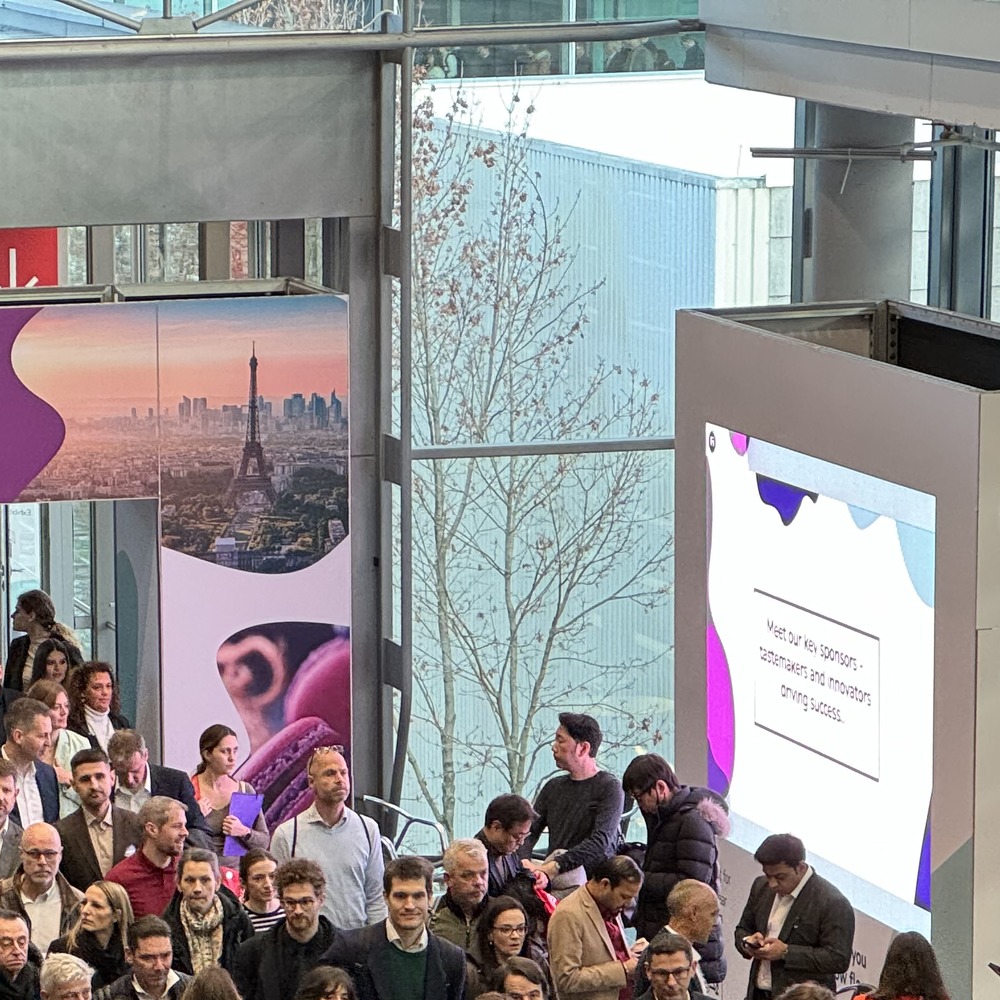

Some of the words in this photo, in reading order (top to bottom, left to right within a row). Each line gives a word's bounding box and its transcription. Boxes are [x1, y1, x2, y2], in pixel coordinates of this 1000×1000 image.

[766, 617, 787, 642] Meet
[788, 631, 802, 646] our
[804, 634, 818, 657] key
[820, 643, 858, 671] sponsors
[759, 645, 808, 679] tastemakers
[810, 668, 825, 686] and
[851, 949, 867, 969] you
